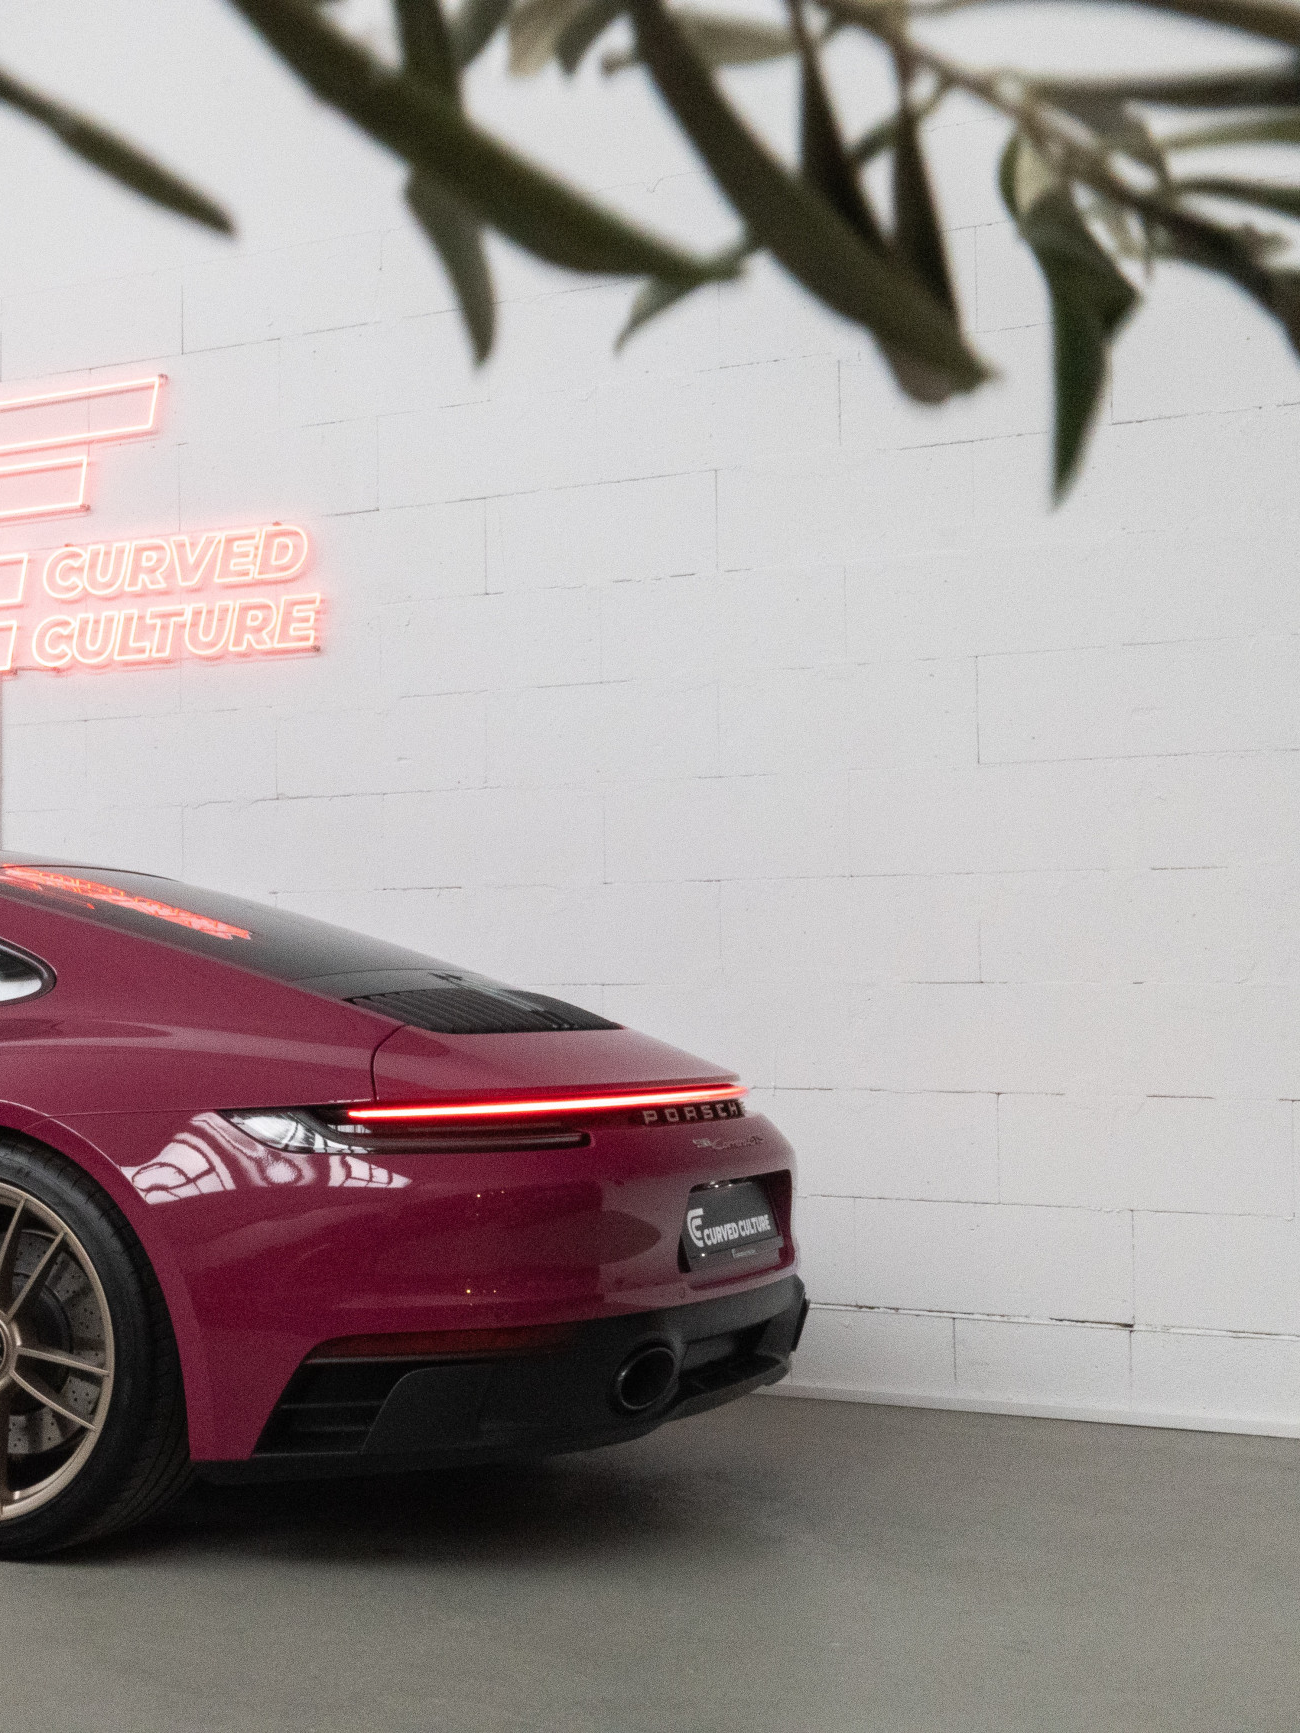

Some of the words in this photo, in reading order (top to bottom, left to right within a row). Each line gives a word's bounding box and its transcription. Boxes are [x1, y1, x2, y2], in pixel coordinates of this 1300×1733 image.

[42, 524, 310, 600] CURVED
[31, 593, 324, 669] CULTURE
[703, 1222, 740, 1246] CURVED
[737, 1214, 772, 1237] CULTURE
